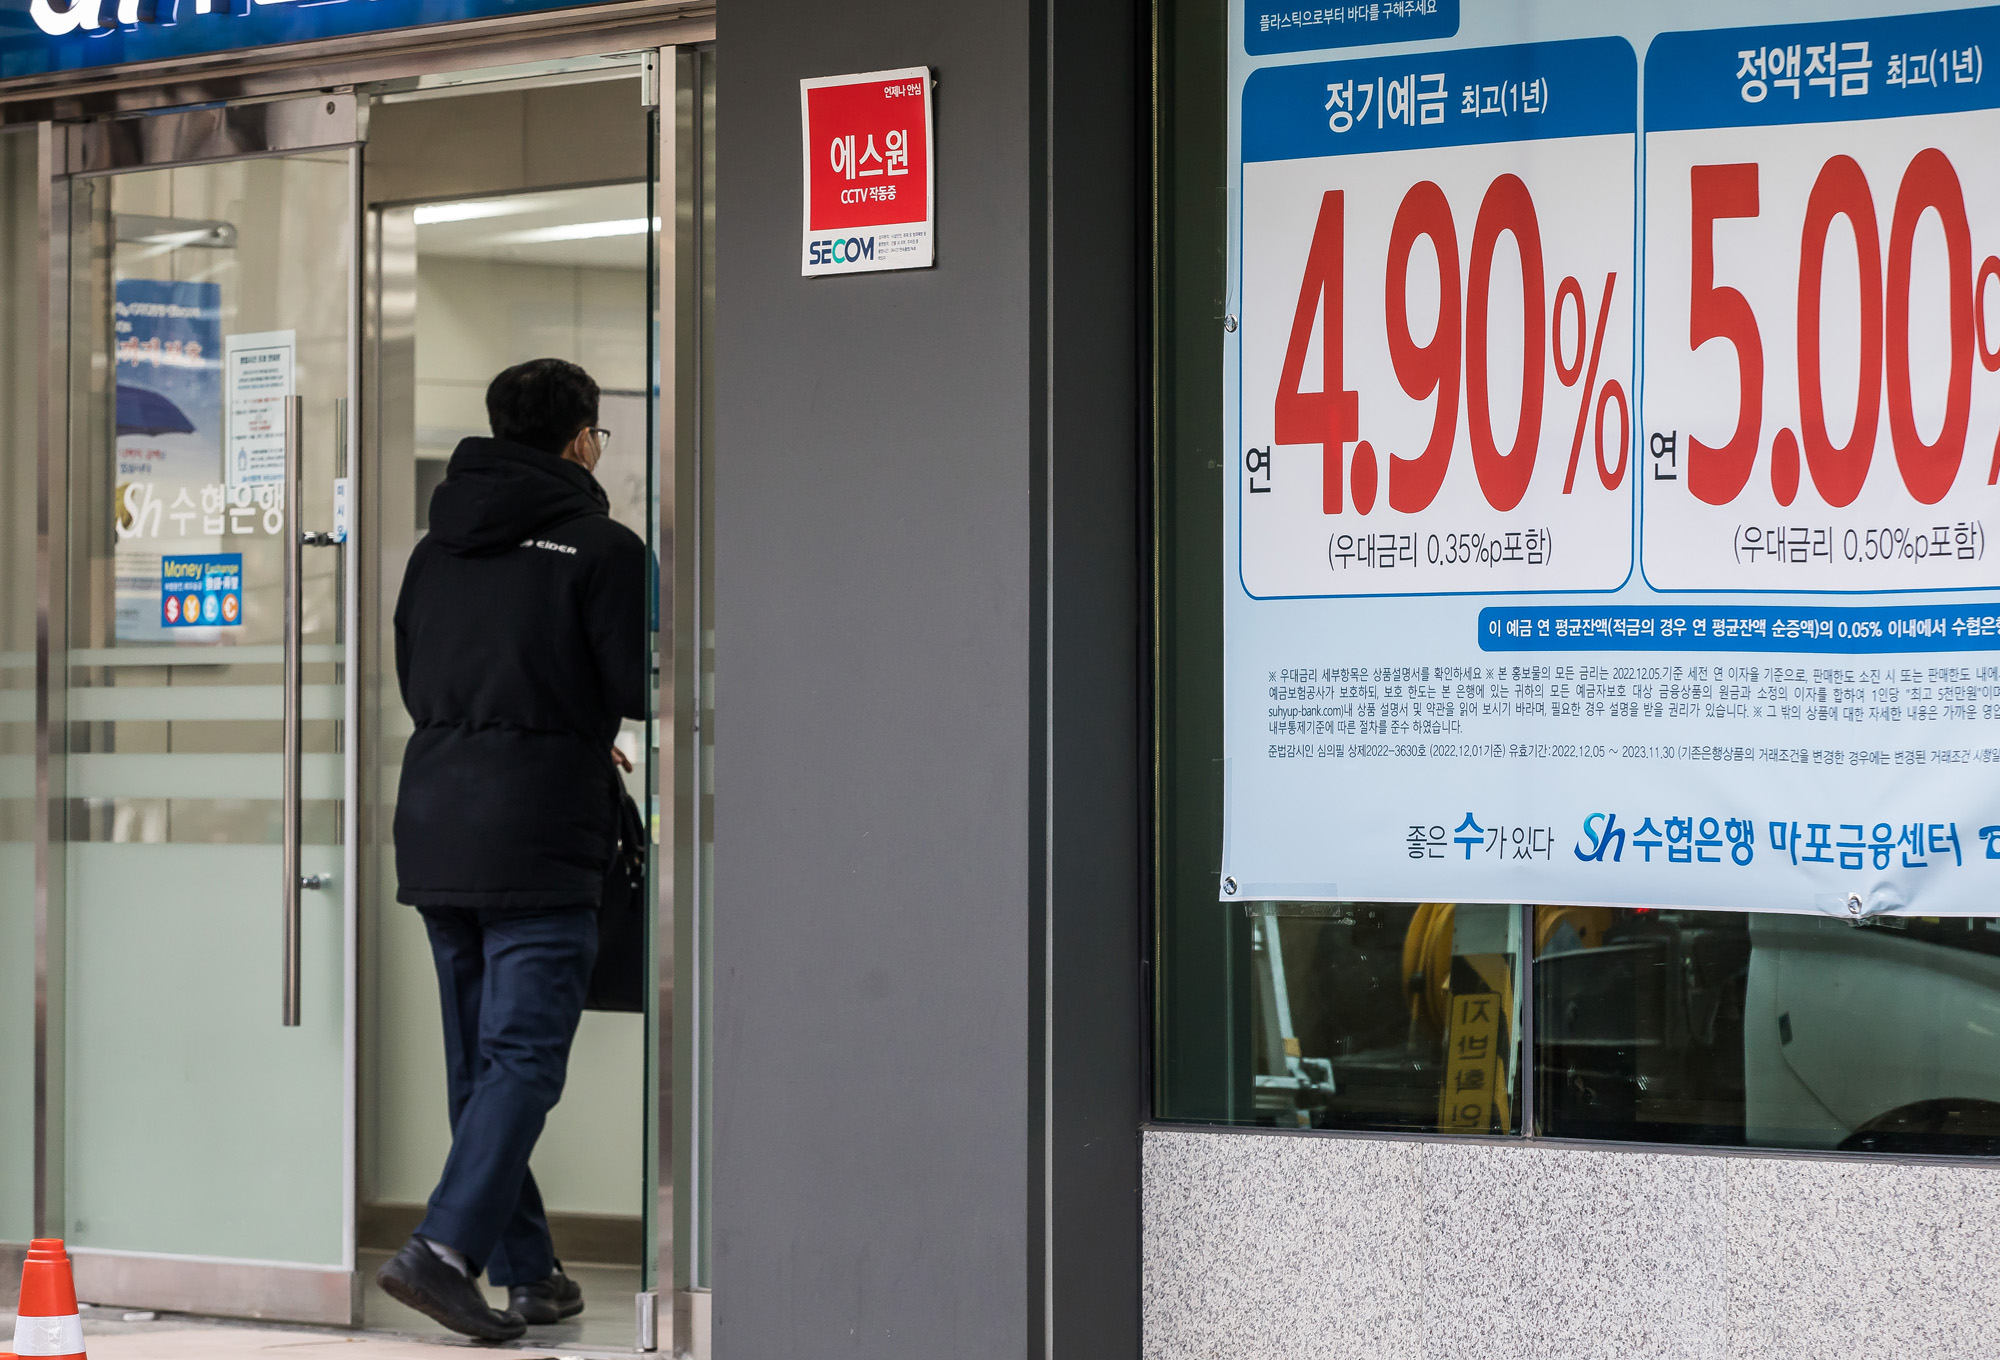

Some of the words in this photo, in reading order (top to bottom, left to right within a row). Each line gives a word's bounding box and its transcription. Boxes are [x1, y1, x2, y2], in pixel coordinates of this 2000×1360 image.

[1259, 6, 1345, 32] 플라스틱으로부터
[1347, 3, 1380, 23] 바다를
[1382, 0, 1438, 20] 구해주세요
[1735, 41, 1873, 104] 정액적금
[1885, 44, 1983, 89] 최고(1년)
[883, 86, 906, 98] 언제나
[907, 83, 922, 97] 안심
[1324, 72, 1449, 133] 정기예금
[1460, 76, 1548, 118] 최고(1년)
[830, 129, 909, 181] 에스원
[840, 187, 868, 205] CCTV
[869, 185, 897, 202] 작동중
[809, 236, 875, 266] SECOM
[1245, 445, 1272, 494] 연
[1274, 173, 1630, 516] 4.90%
[1649, 430, 1677, 481] 연
[117, 482, 163, 539] Sh
[169, 482, 284, 536] 수협은행
[1328, 531, 1417, 571] (우대금리
[1427, 527, 1552, 569] 0.35%p포함)
[1734, 524, 1833, 565] (우대금리
[1843, 520, 1985, 565] 0.50%p포함)
[164, 560, 203, 580] Money
[1489, 620, 1500, 637] 이
[1506, 619, 1532, 637] 예금
[1537, 619, 1549, 636] 연
[1555, 617, 1654, 637] 평균잔액(적금의
[1660, 618, 1687, 637] 경우
[1692, 618, 1706, 636] 연
[1712, 619, 1766, 637] 평균잔액
[1771, 619, 1833, 639] 순증액)의
[1838, 621, 1883, 638] 0.05%
[1888, 618, 1946, 638] 이내에서
[1280, 668, 1317, 683] 우대금리
[1322, 668, 1369, 682] 세부항목은
[1373, 667, 1430, 682] 상품설명서를
[1434, 667, 1482, 681] 확인하세요
[1498, 667, 1507, 680] 본
[1512, 666, 1550, 681] 홍보물의
[1555, 666, 1575, 680] 모든
[1579, 666, 1609, 680] 금리는
[1613, 666, 1683, 681] 2022.12.05.기준
[1688, 666, 1707, 681] 세전
[1714, 667, 1723, 681] 연
[1764, 668, 1808, 684] 기준으로,
[1813, 669, 1855, 684] 판매한도
[1859, 669, 1880, 684] 소진
[1885, 669, 1895, 684] 시
[1900, 669, 1923, 683] 또는
[1928, 667, 1971, 683] 판매한도
[1976, 666, 2000, 681] 내에
[1269, 685, 1335, 700] 예금보험공사가
[1339, 685, 1379, 700] 보호하되,
[1384, 685, 1403, 697] 보호
[1408, 685, 1436, 699] 한도는
[1441, 685, 1451, 698] 본
[1456, 684, 1484, 699] 은행에
[1490, 684, 1509, 698] 있는
[1514, 684, 1543, 698] 귀하의
[1550, 684, 1570, 698] 모든
[1576, 684, 1626, 698] 예금자보호
[1633, 684, 1653, 699] 대상
[1659, 684, 1712, 699] 금융상품의
[1719, 685, 1751, 700] 원금과
[1757, 686, 1787, 701] 소정의
[1794, 687, 1827, 702] 이자를
[1833, 688, 1864, 703] 합하여
[1872, 687, 1900, 702] 1인당
[1906, 687, 1933, 702] "최고
[1269, 703, 1352, 720] suhyup-bank.com)내
[1357, 703, 1376, 717] 상품
[1380, 702, 1408, 717] 설명서
[1413, 702, 1422, 716] 및
[1426, 702, 1455, 716] 약관을
[1460, 702, 1477, 716] 읽어
[1482, 702, 1510, 716] 보시기
[1516, 702, 1546, 717] 바라며,
[1551, 702, 1581, 716] 필요한
[1585, 702, 1605, 716] 경우
[1609, 702, 1639, 717] 설명을
[1644, 702, 1663, 717] 받을
[1668, 703, 1700, 718] 권리가
[1705, 703, 1749, 718] 있습니다.
[1766, 705, 1777, 717] 그
[1781, 705, 1801, 720] 밖의
[1806, 706, 1838, 721] 상품에
[1843, 707, 1864, 722] 대한
[1869, 706, 1902, 721] 자세한
[1907, 705, 1938, 721] 내용은
[1943, 705, 1977, 720] 가까운
[1269, 719, 1334, 735] 내부통제기준에
[1338, 720, 1356, 734] 따른
[1360, 720, 1387, 734] 절차를
[1391, 720, 1409, 734] 준수
[1413, 720, 1462, 734] 하였습니다.
[1268, 744, 1313, 758] 준법감시인
[1317, 744, 1344, 757] 심의필
[1348, 744, 1426, 758] 상제2022-3630호
[1430, 744, 1505, 758] (2022.12.01기준)
[1509, 744, 1605, 758] 유효기간:2022.12.05
[1622, 746, 1675, 759] 2023.11.30
[1678, 745, 1754, 761] (기존은행상품의
[1759, 748, 1809, 763] 거래조건을
[1813, 750, 1845, 765] 변경한
[1848, 751, 1891, 766] 경우에는
[1895, 750, 1926, 765] 변경된
[1931, 749, 1970, 764] 거래조건
[1406, 825, 1448, 859] 좋은
[1453, 812, 1507, 861] 수가
[1512, 826, 1555, 861] 있다
[1573, 812, 1627, 863] Sh
[1632, 815, 1755, 867] 수협은행
[1768, 822, 1963, 871] 마포금융센터
